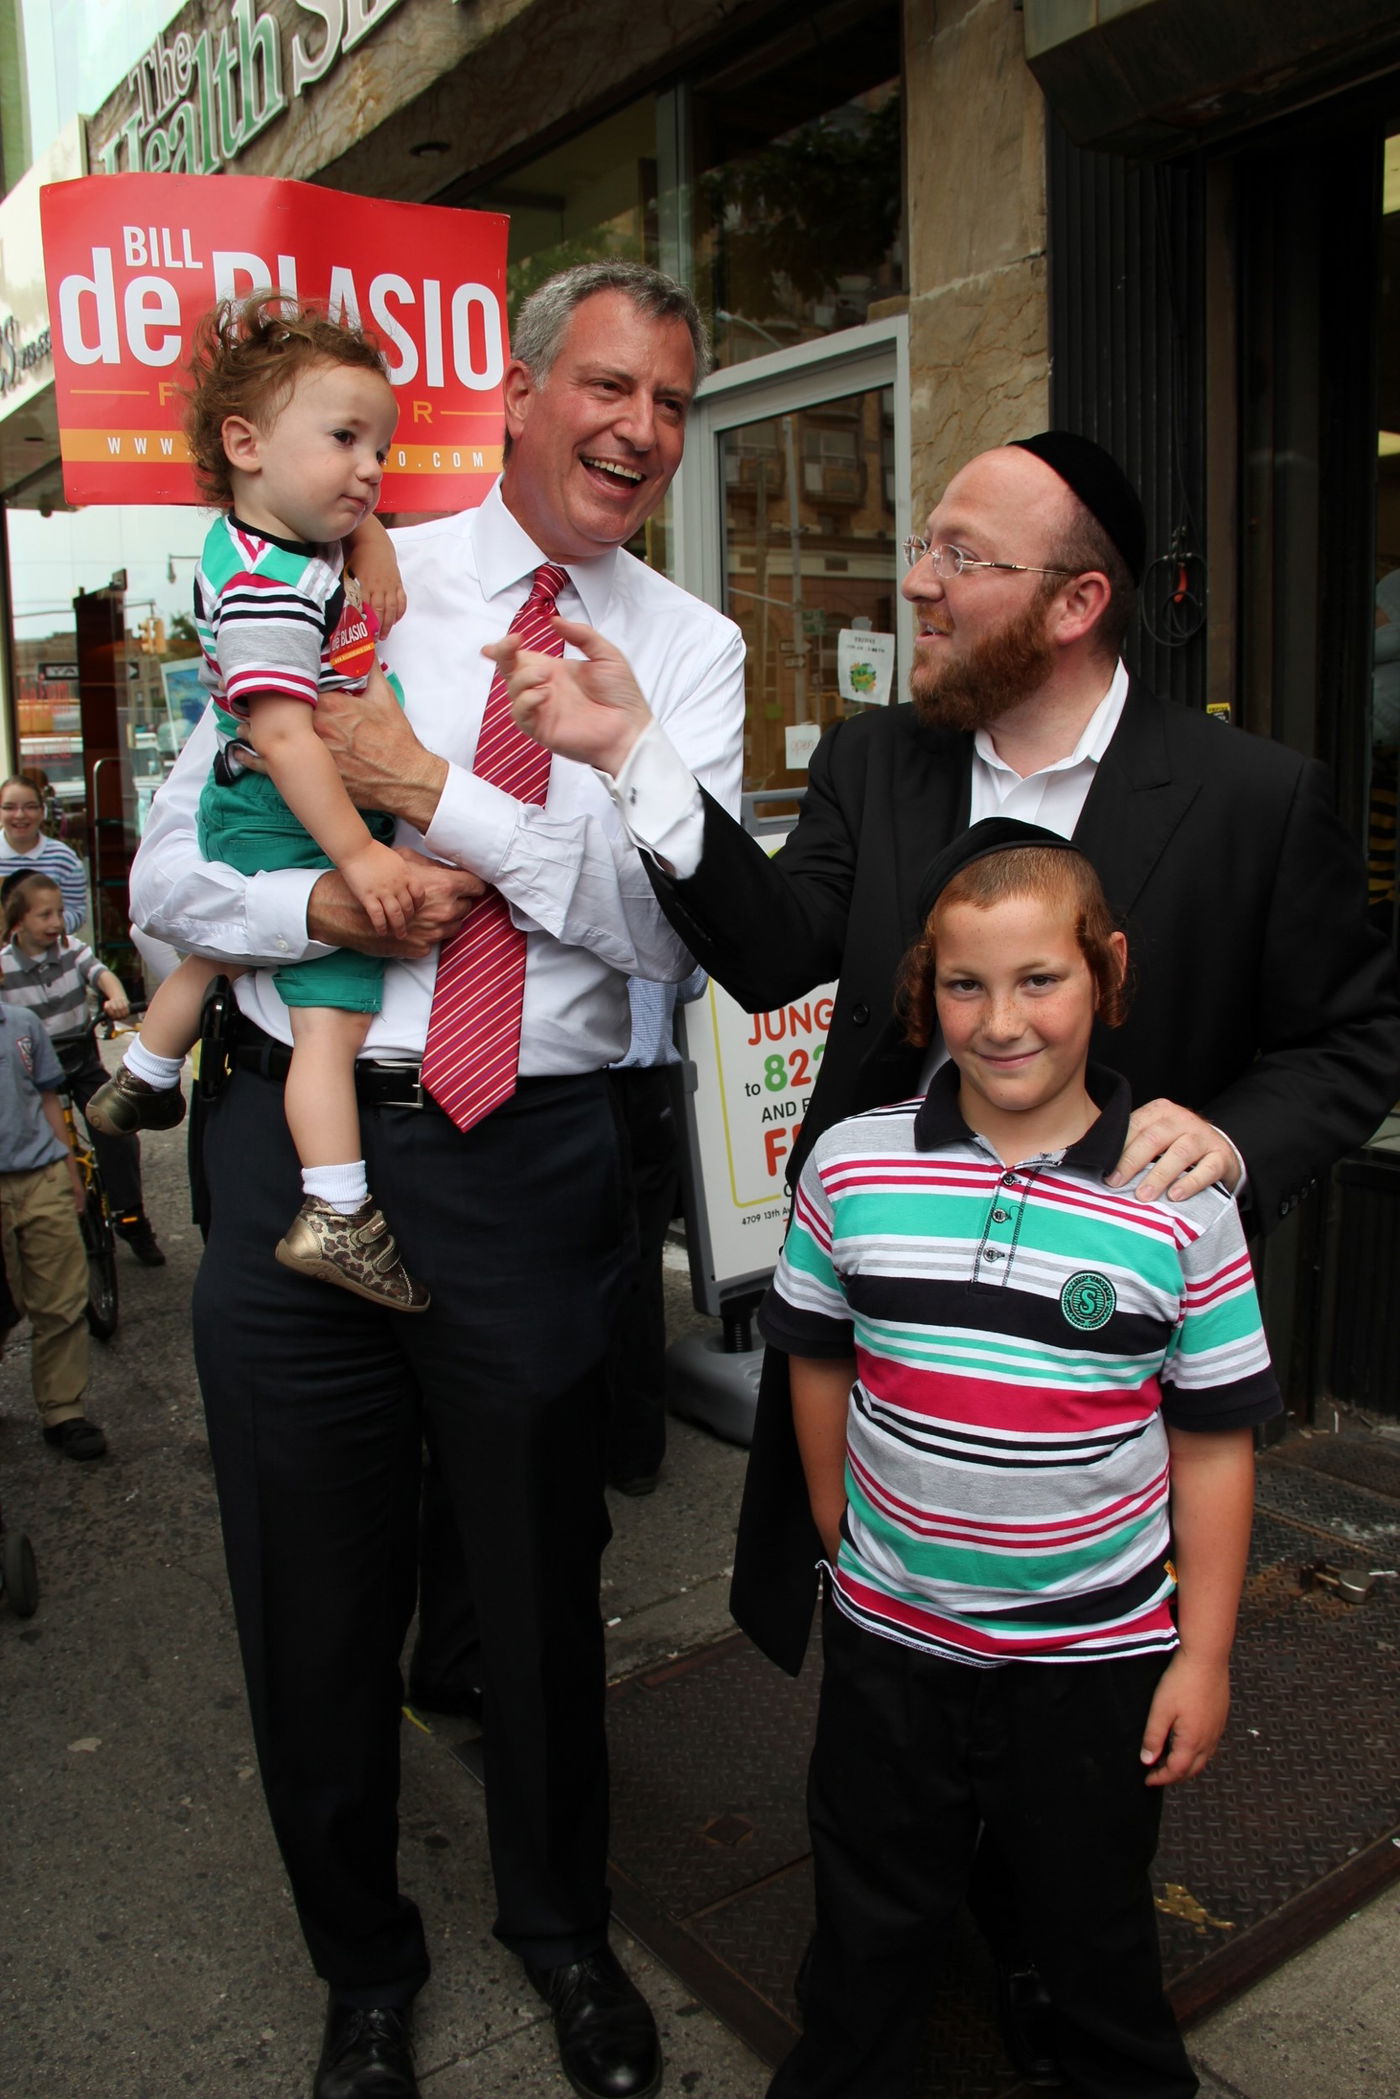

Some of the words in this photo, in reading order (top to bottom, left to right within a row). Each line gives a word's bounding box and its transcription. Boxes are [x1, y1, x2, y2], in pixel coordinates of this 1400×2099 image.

[128, 30, 194, 131] The
[123, 225, 204, 269] BILL
[58, 247, 182, 368] de
[341, 621, 368, 647] BLASIO
[745, 1082, 761, 1097] to
[761, 1101, 797, 1123] AND
[742, 1213, 761, 1226] 4709
[763, 1207, 780, 1220] 13th
